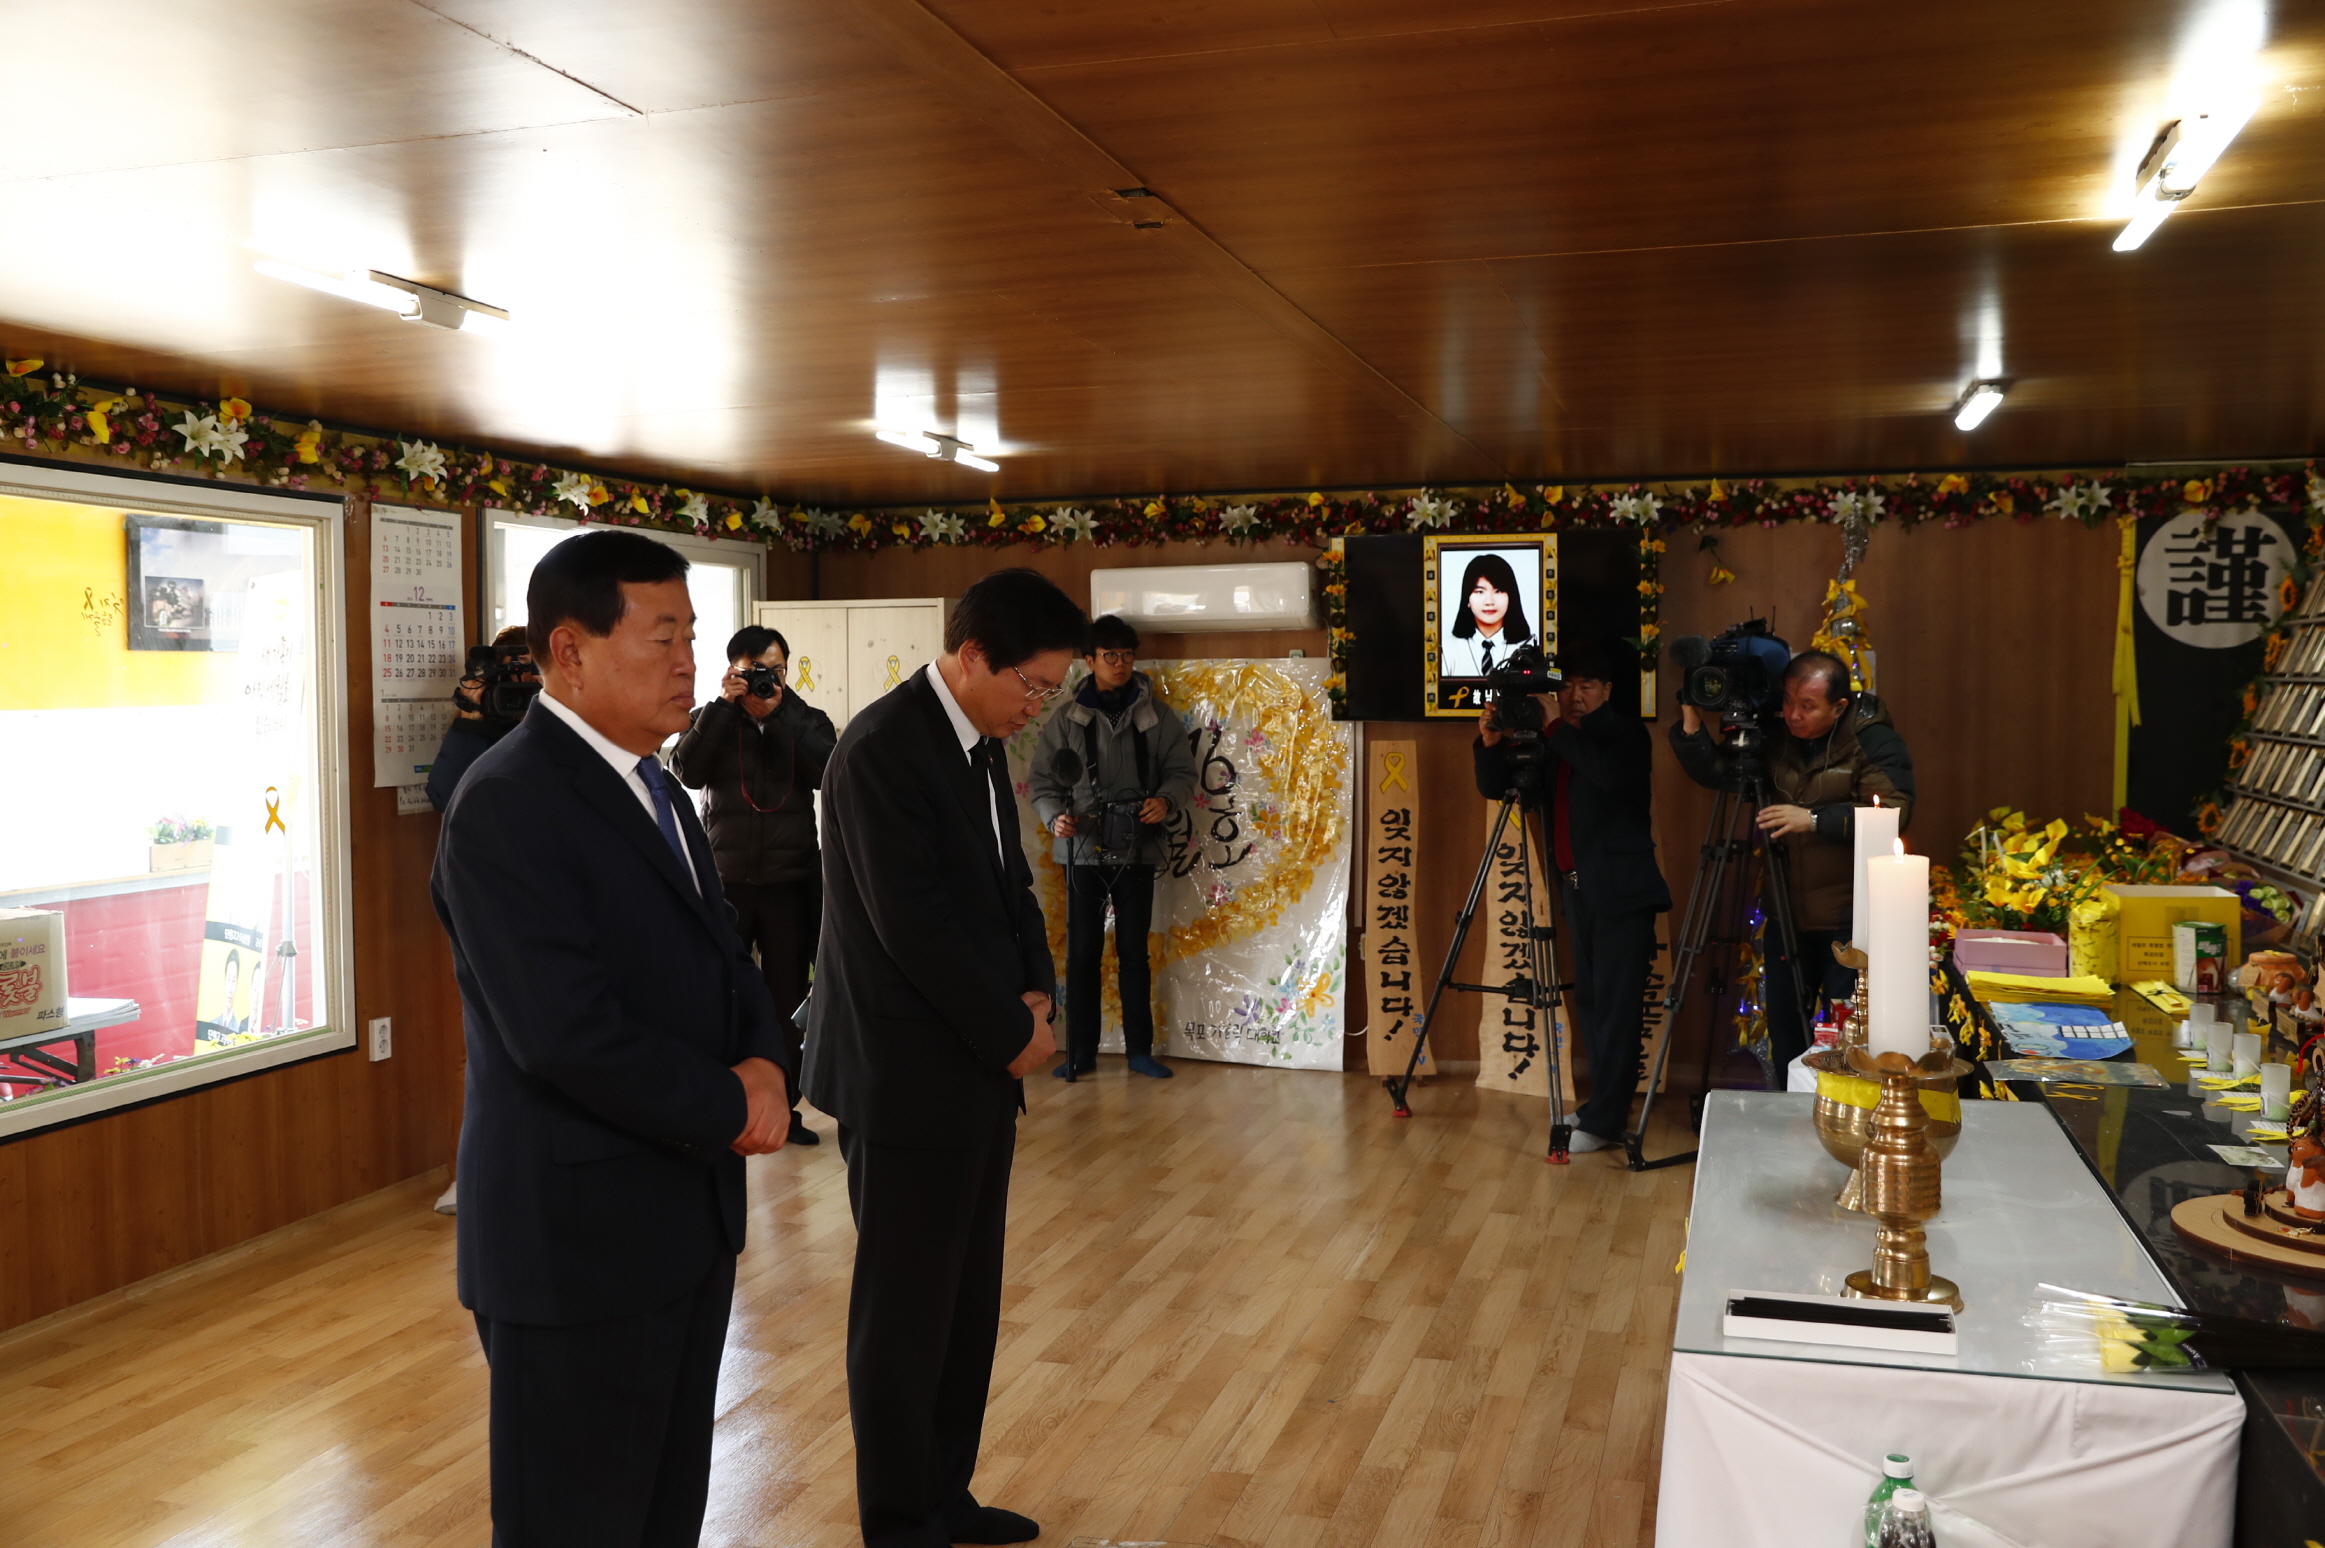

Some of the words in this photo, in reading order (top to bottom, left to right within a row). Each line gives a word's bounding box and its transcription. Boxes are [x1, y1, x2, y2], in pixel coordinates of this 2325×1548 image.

[383, 555, 389, 563] 20
[406, 557, 411, 565] 22
[2165, 526, 2277, 626] 謹
[414, 586, 425, 602] 12
[428, 612, 432, 620] 1
[439, 612, 443, 621] 2
[449, 612, 453, 621] 3
[384, 624, 389, 633] 4
[396, 625, 401, 633] 5
[408, 625, 412, 634] 6
[418, 625, 422, 634] 7
[428, 626, 433, 634] 8
[439, 626, 443, 635] 9
[448, 626, 455, 635] 10
[383, 639, 391, 647] 11
[395, 639, 403, 648] 12
[406, 640, 414, 648] 13
[417, 640, 424, 648] 14
[428, 640, 435, 649] 15
[439, 640, 445, 649] 16
[448, 641, 455, 649] 17
[383, 654, 392, 663] 18
[395, 654, 403, 663] 19
[406, 654, 414, 663] 20
[417, 654, 425, 663] 21
[428, 655, 436, 663] 22
[439, 655, 446, 663] 23
[448, 655, 456, 663] 24
[383, 668, 392, 678] 25
[395, 668, 403, 678] 26
[406, 668, 414, 678] 27
[417, 669, 426, 678] 28
[428, 669, 436, 678] 29
[439, 669, 446, 678] 30
[449, 669, 456, 678] 31
[398, 714, 401, 722] 9
[37, 1006, 64, 1020] 파스형
[1184, 1022, 1205, 1041] 목포
